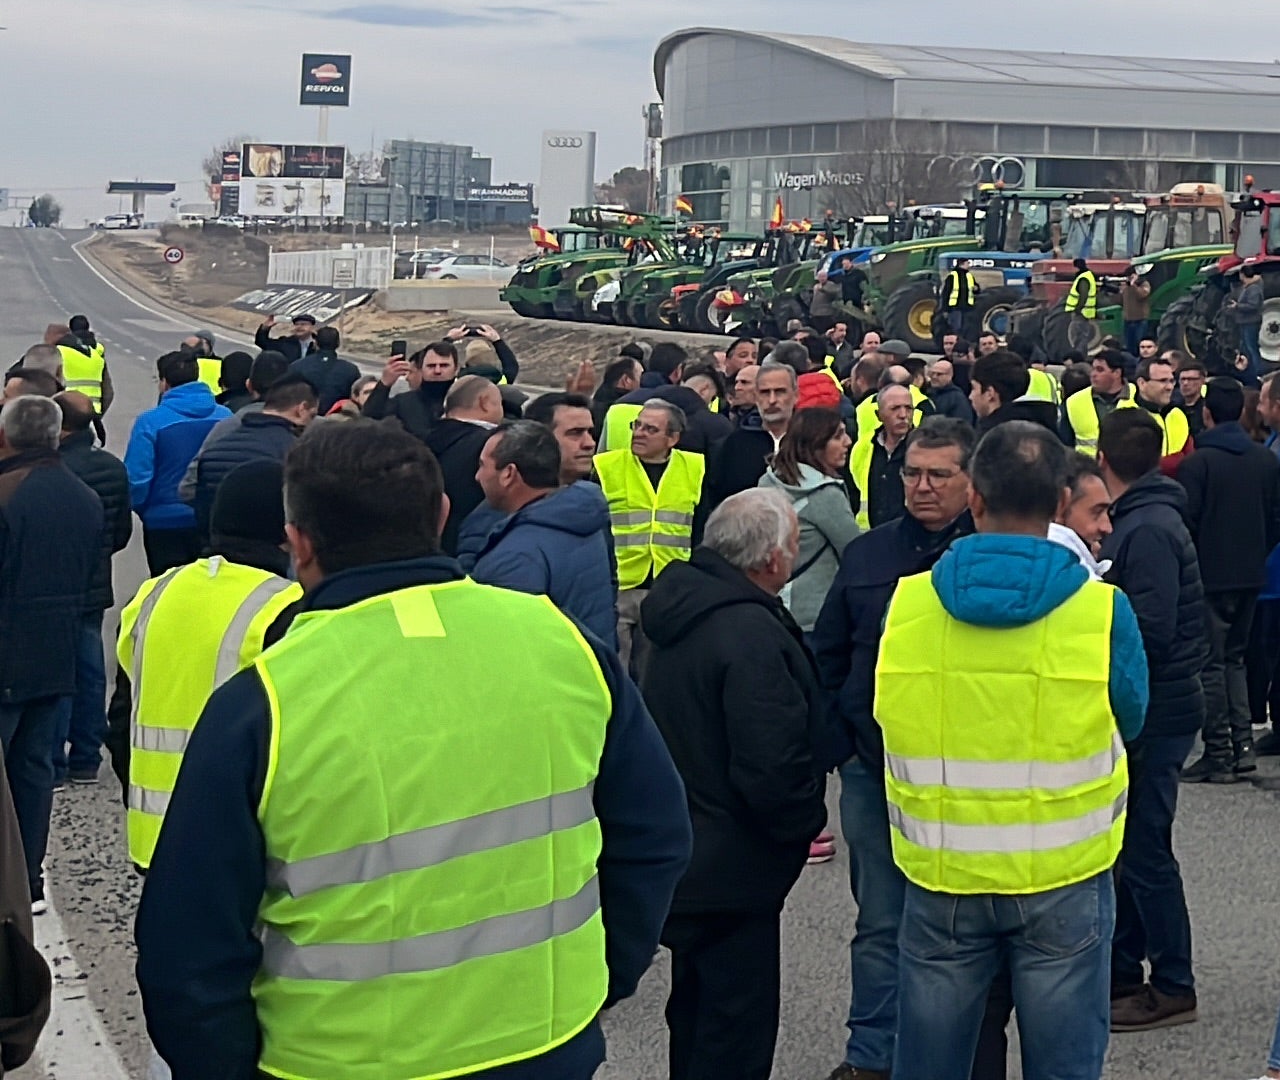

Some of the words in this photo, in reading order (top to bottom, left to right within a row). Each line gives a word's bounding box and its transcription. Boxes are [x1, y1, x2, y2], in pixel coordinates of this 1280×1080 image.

[304, 84, 345, 93] REPSOL
[774, 171, 815, 191] Wagen
[818, 170, 865, 186] Motors
